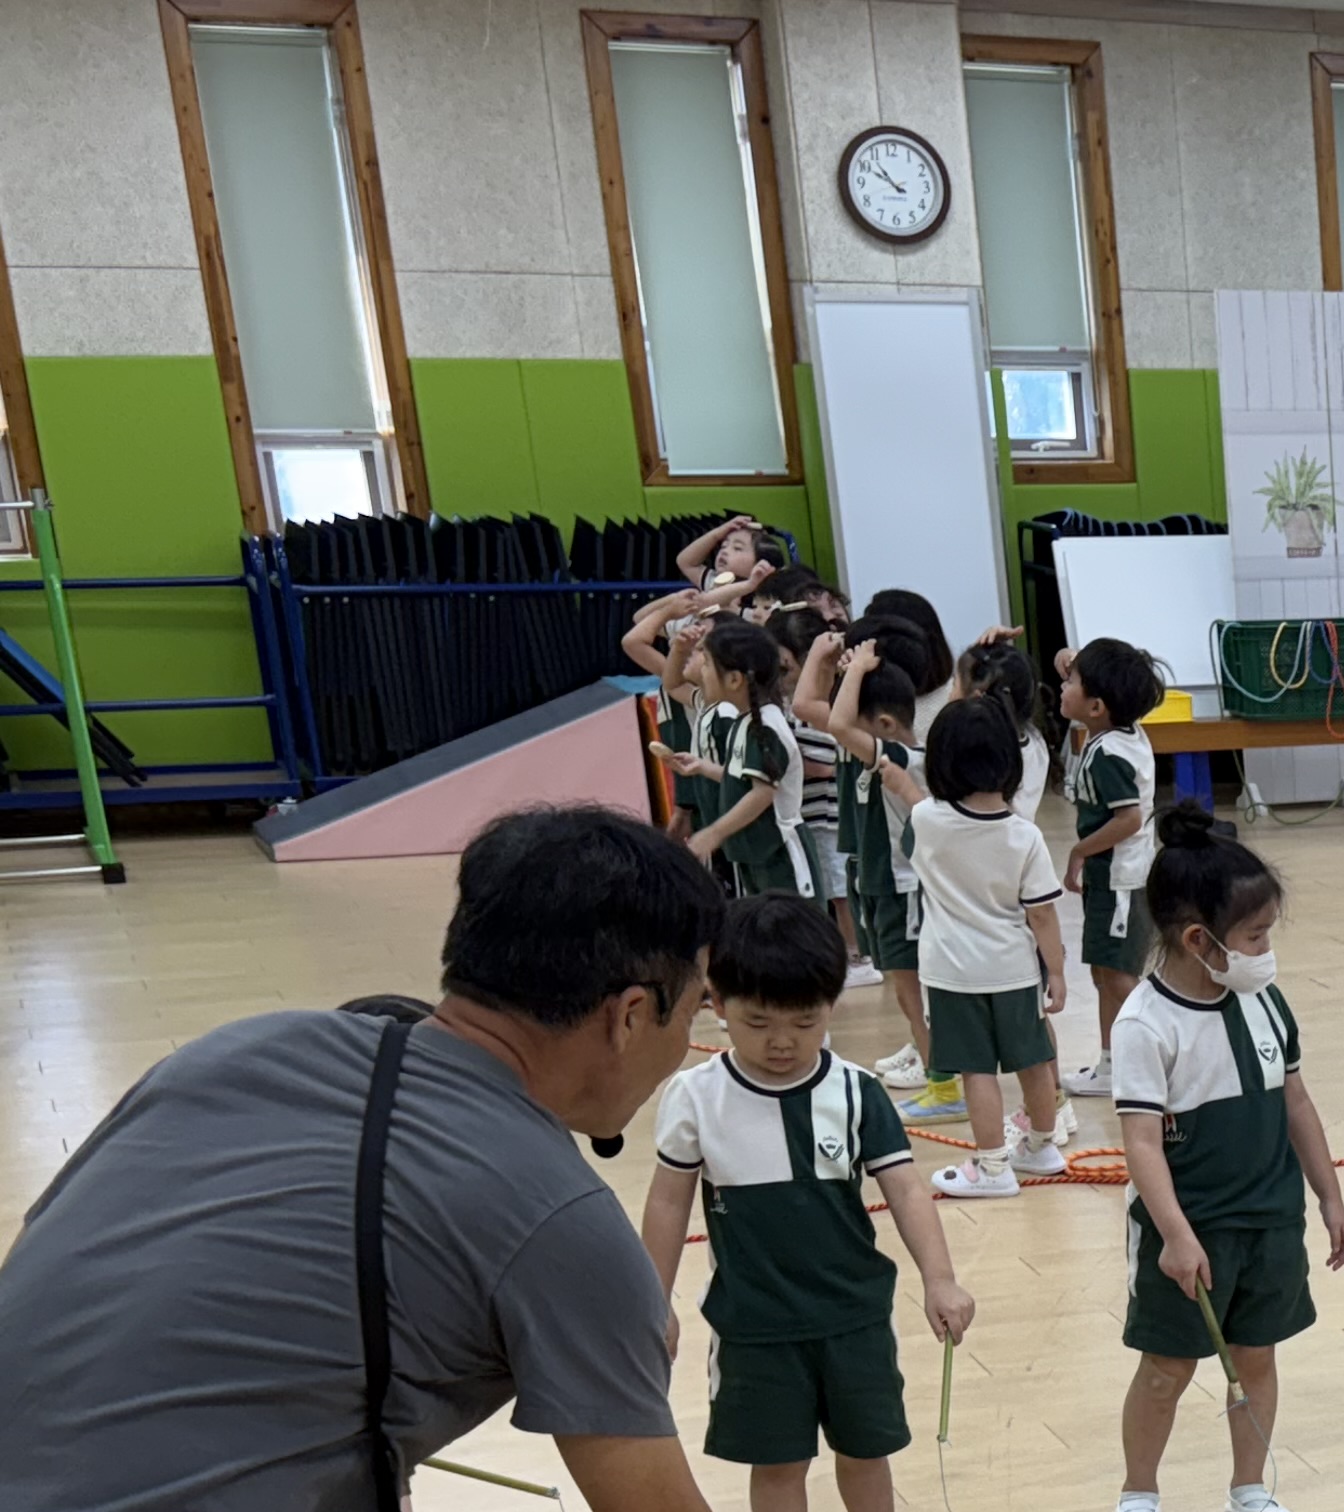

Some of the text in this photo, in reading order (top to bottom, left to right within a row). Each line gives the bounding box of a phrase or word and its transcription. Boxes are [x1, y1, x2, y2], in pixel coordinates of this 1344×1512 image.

[870, 147, 879, 160] 11
[886, 143, 898, 157] 12
[859, 160, 871, 173] 10
[918, 164, 926, 177] 2
[857, 176, 866, 189] 9
[923, 180, 930, 194] 3
[863, 195, 871, 207] 8
[918, 199, 926, 211] 4
[876, 208, 884, 220] 7
[892, 212, 900, 225] 6
[909, 211, 916, 224] 5
